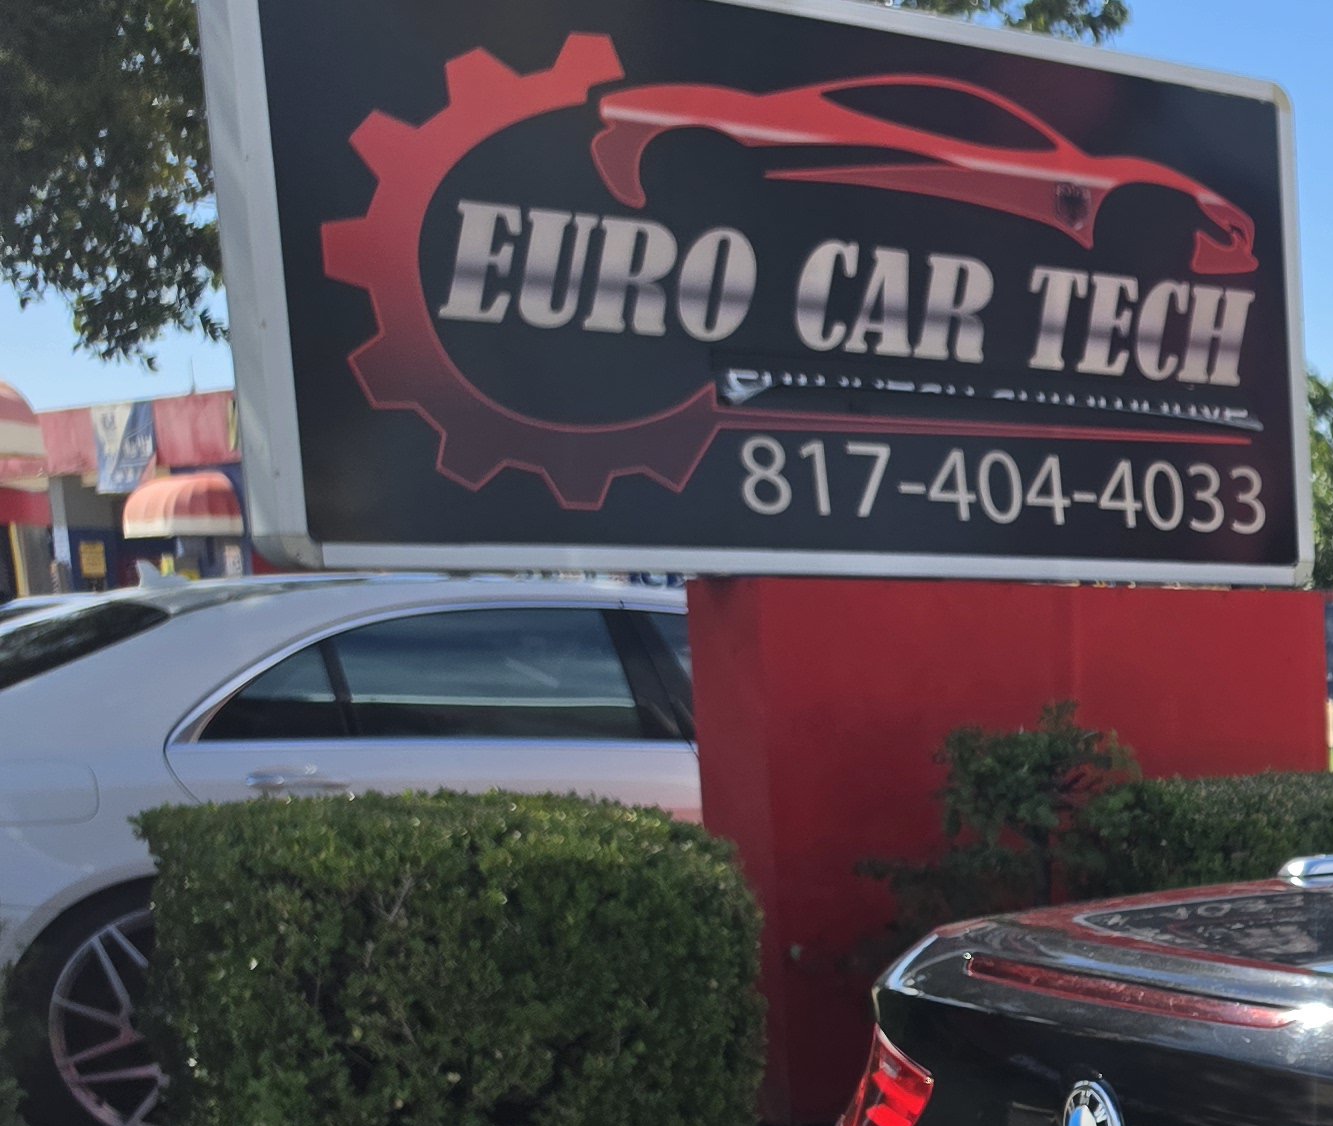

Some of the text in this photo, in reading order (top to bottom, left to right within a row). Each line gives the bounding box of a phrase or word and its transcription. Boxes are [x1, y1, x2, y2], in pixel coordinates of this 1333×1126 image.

[439, 200, 1255, 387] EURO CAR TECH
[740, 435, 1266, 534] 817-404-4033
